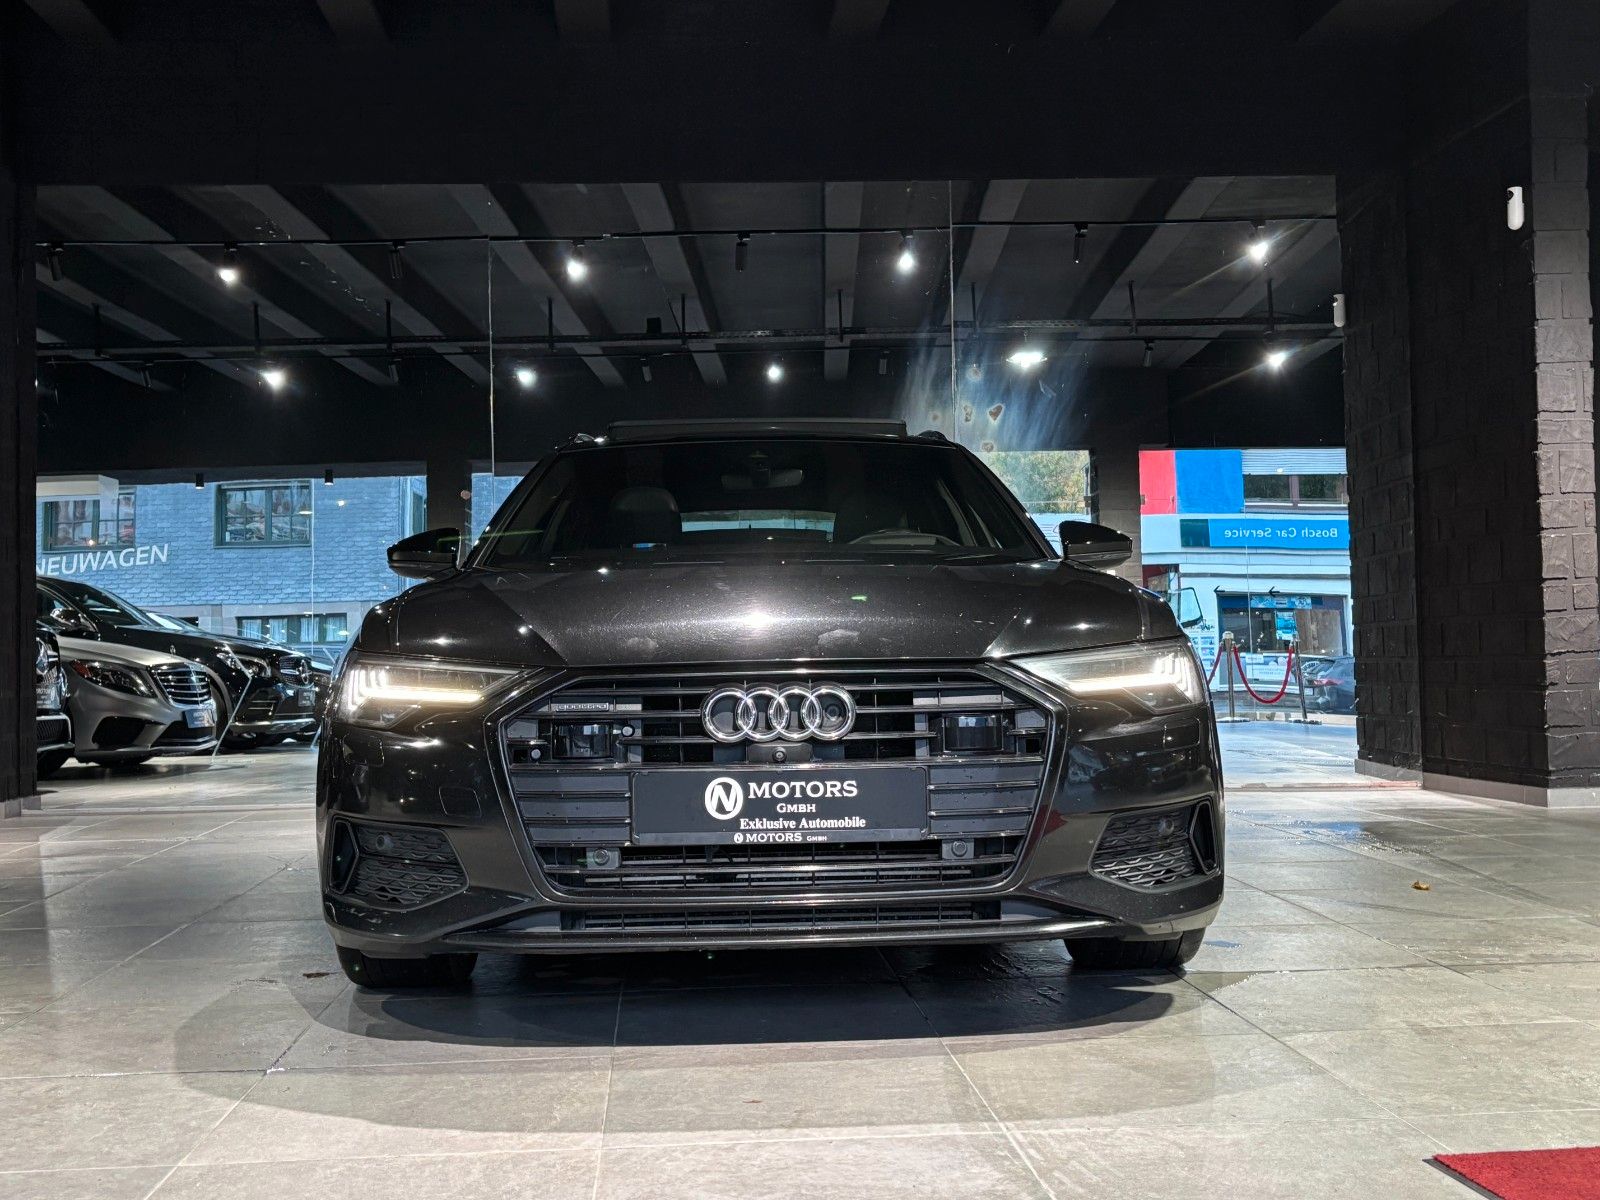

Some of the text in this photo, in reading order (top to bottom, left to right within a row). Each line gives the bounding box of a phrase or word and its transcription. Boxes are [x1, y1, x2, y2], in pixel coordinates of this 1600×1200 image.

[36, 543, 169, 576] NEUWAGEN
[748, 780, 858, 799] MOTORS
[776, 803, 816, 813] GMBH
[740, 816, 866, 830] Exklusive Automobile
[745, 832, 802, 843] MOTORS
